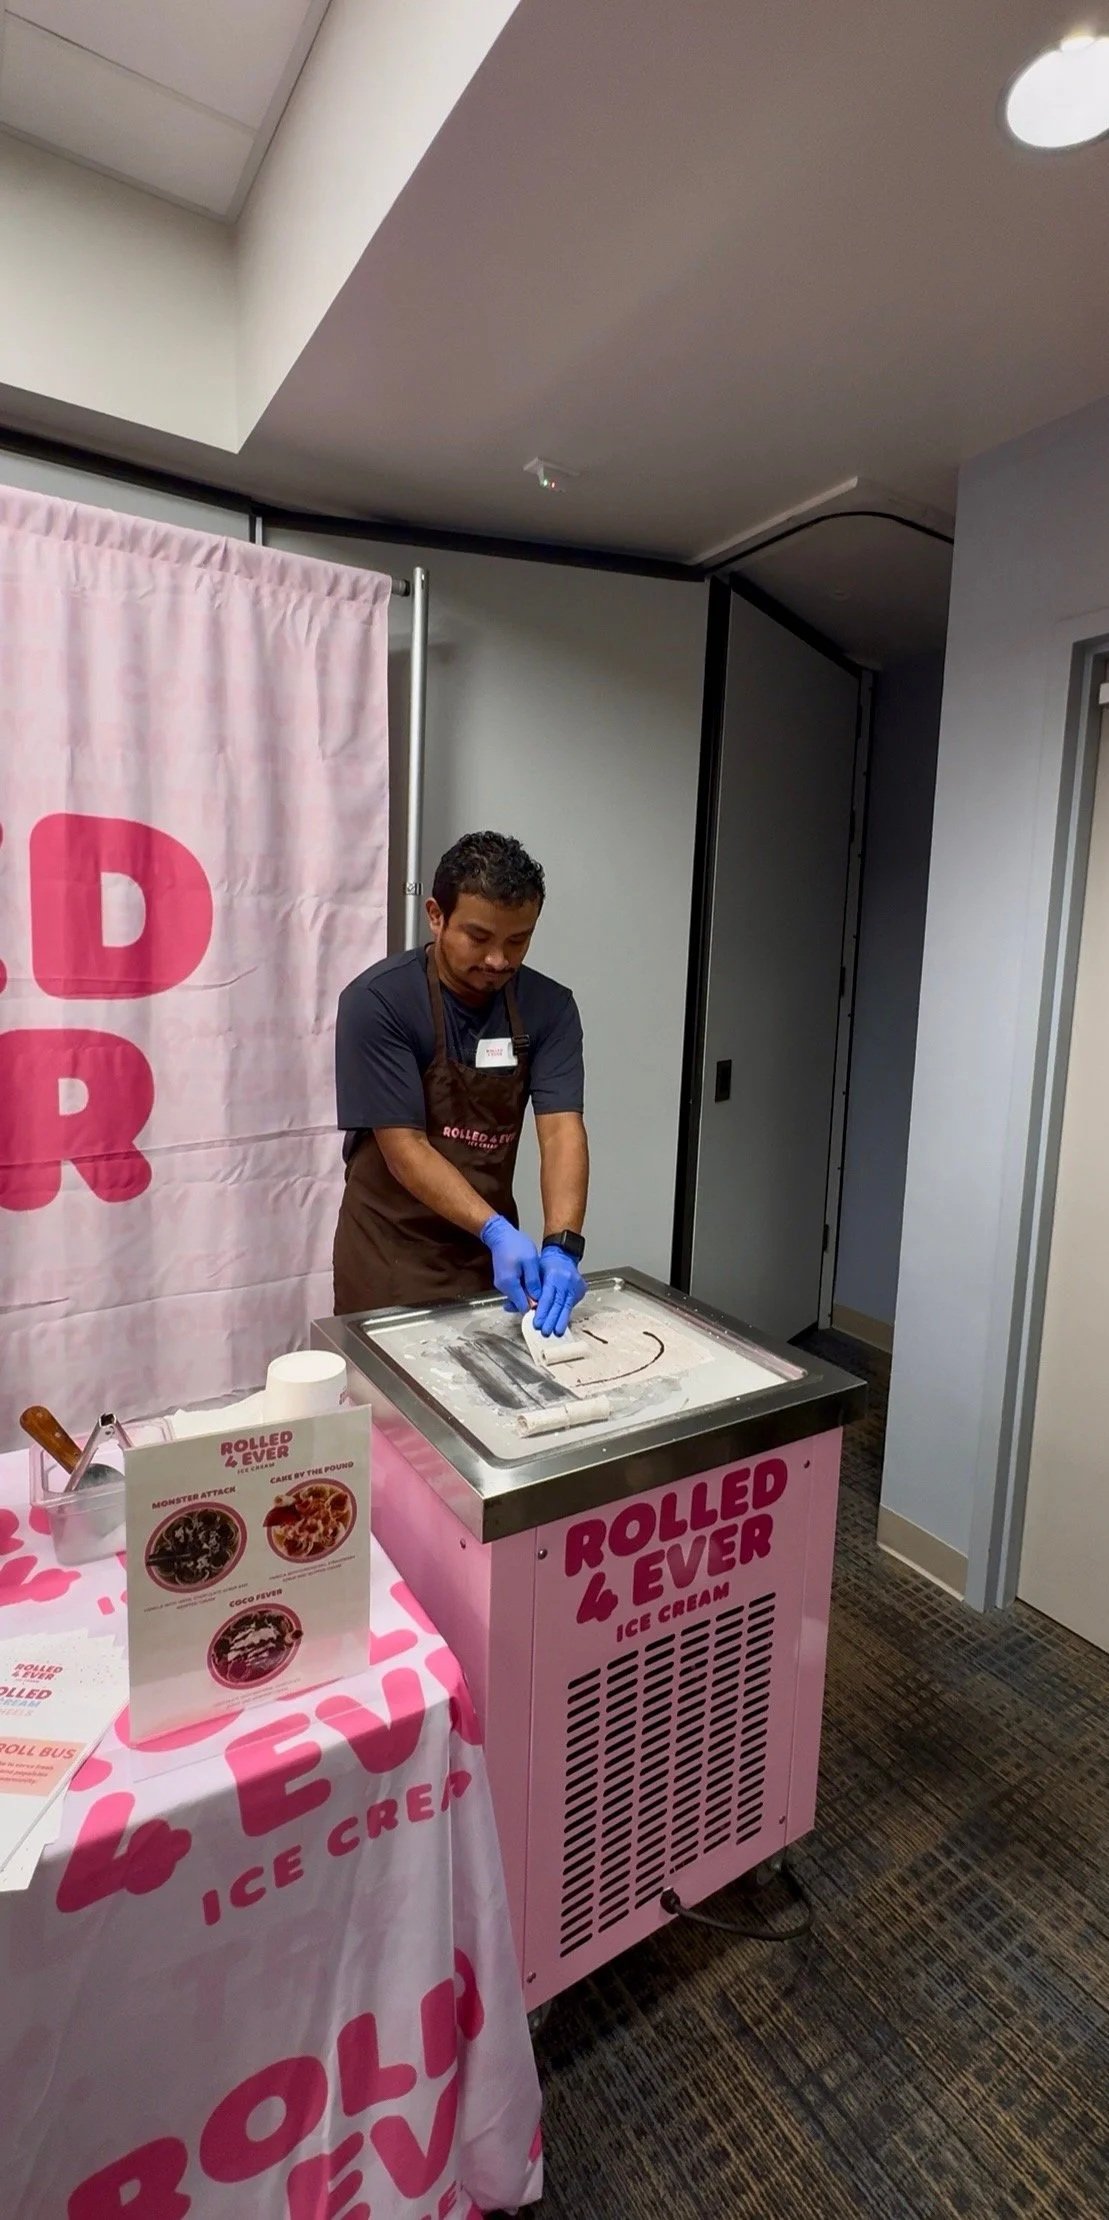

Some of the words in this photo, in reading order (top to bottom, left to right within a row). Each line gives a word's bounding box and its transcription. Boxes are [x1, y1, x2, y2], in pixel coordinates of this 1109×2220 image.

[0, 812, 214, 999] D
[443, 1126, 488, 1142] ROLLED
[221, 1430, 293, 1456] ROLLED
[224, 1456, 238, 1468] 4
[242, 1445, 289, 1466] EVER
[250, 1462, 275, 1472] CREAM
[270, 1474, 293, 1484] CAKE
[294, 1471, 306, 1480] BY
[307, 1467, 324, 1477] THE
[324, 1461, 354, 1473] POUND
[152, 1493, 199, 1509] MONSTER
[200, 1486, 236, 1499] ATTACK
[565, 1458, 788, 1577] ROLLED
[576, 1572, 619, 1624] 4
[632, 1513, 774, 1607] EVER
[229, 1594, 255, 1608] COCO
[255, 1588, 283, 1601] FEVER
[616, 1611, 652, 1643] ICE
[658, 1581, 731, 1624] CREAM
[14, 1663, 64, 1675] ROLLED
[21, 1671, 56, 1681] EVER
[39, 1747, 77, 1760] BUS
[56, 1792, 193, 1913] 4
[202, 1845, 305, 1927] ICE
